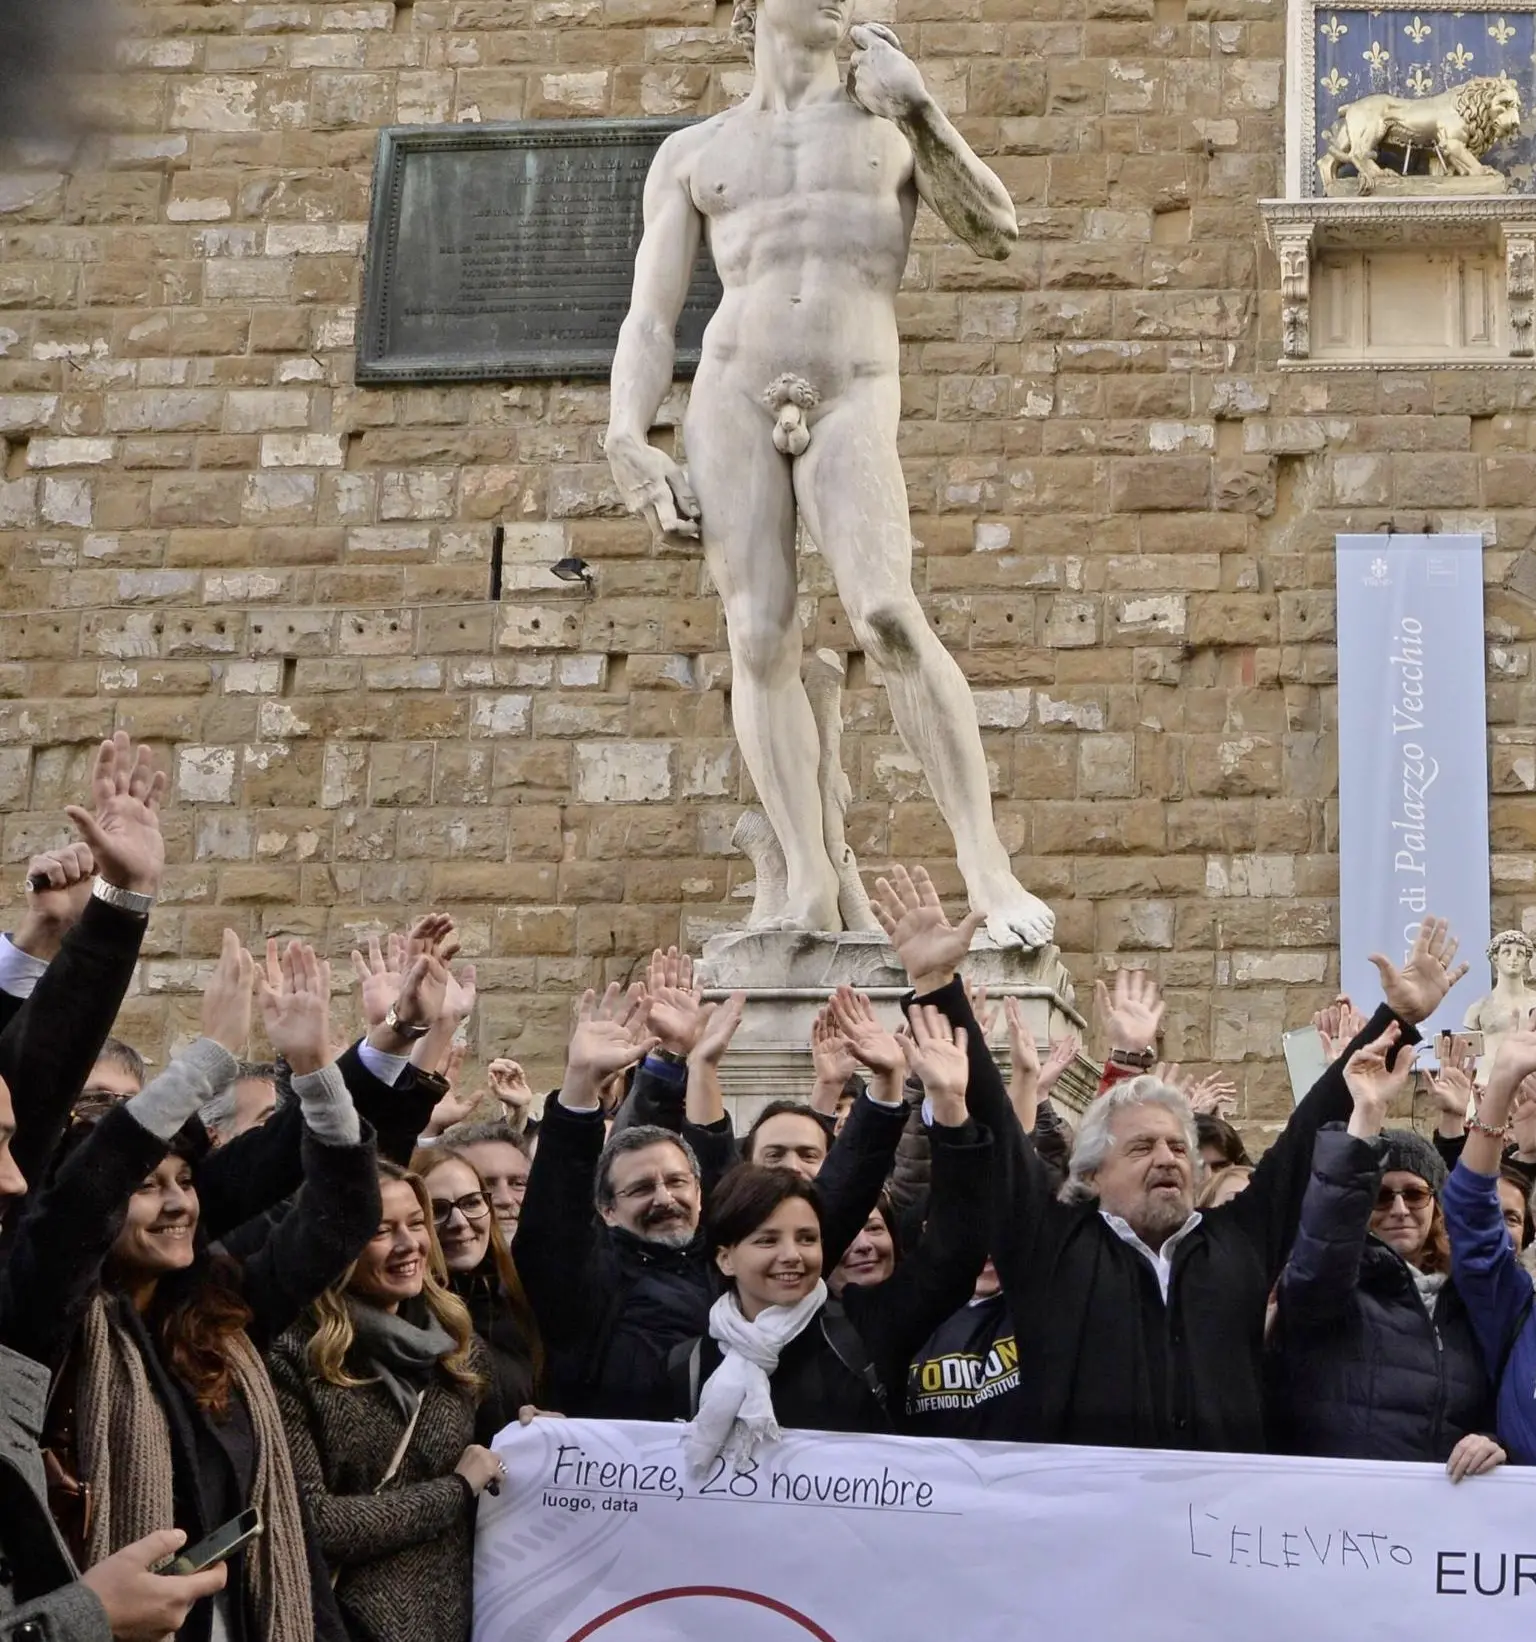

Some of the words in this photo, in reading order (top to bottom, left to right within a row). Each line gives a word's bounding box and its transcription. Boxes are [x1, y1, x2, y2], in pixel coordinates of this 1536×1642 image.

[1389, 616, 1424, 735] Vecchio
[1391, 742, 1440, 877] Palazzo
[1399, 885, 1427, 913] di
[961, 1396, 975, 1408] LA
[553, 1444, 685, 1502] Firenze,
[699, 1454, 760, 1497] 28
[771, 1466, 934, 1508] novembre
[542, 1492, 595, 1512] luogo,
[602, 1496, 638, 1512] data
